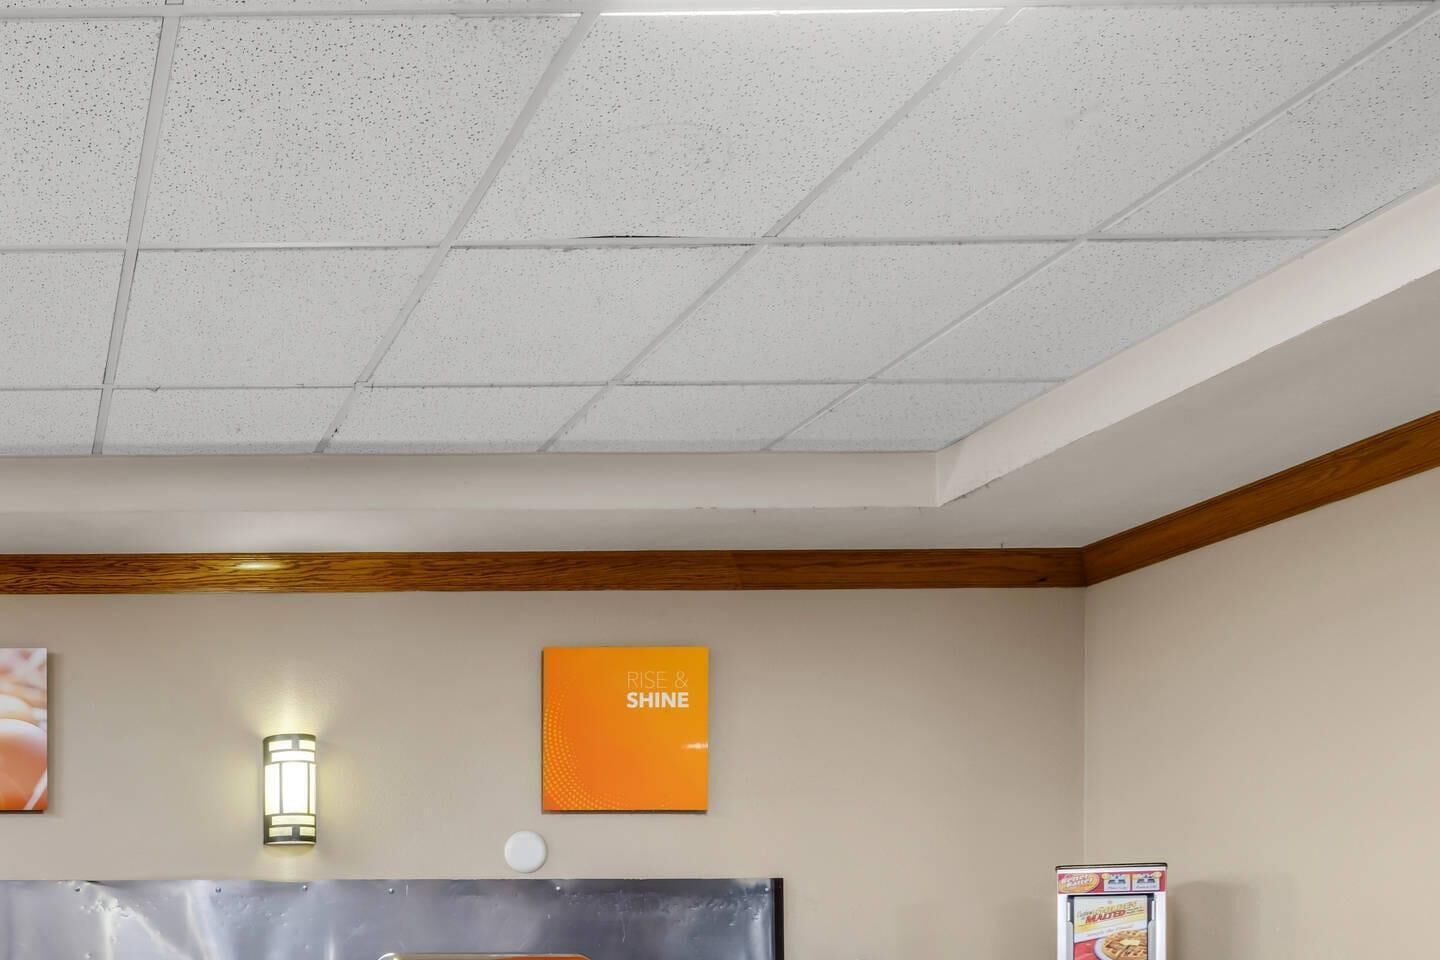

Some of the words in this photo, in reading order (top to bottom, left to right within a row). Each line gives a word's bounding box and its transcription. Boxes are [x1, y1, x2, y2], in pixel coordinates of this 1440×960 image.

[627, 671, 667, 689] RISE
[674, 670, 689, 689] &
[626, 691, 689, 709] SHINE
